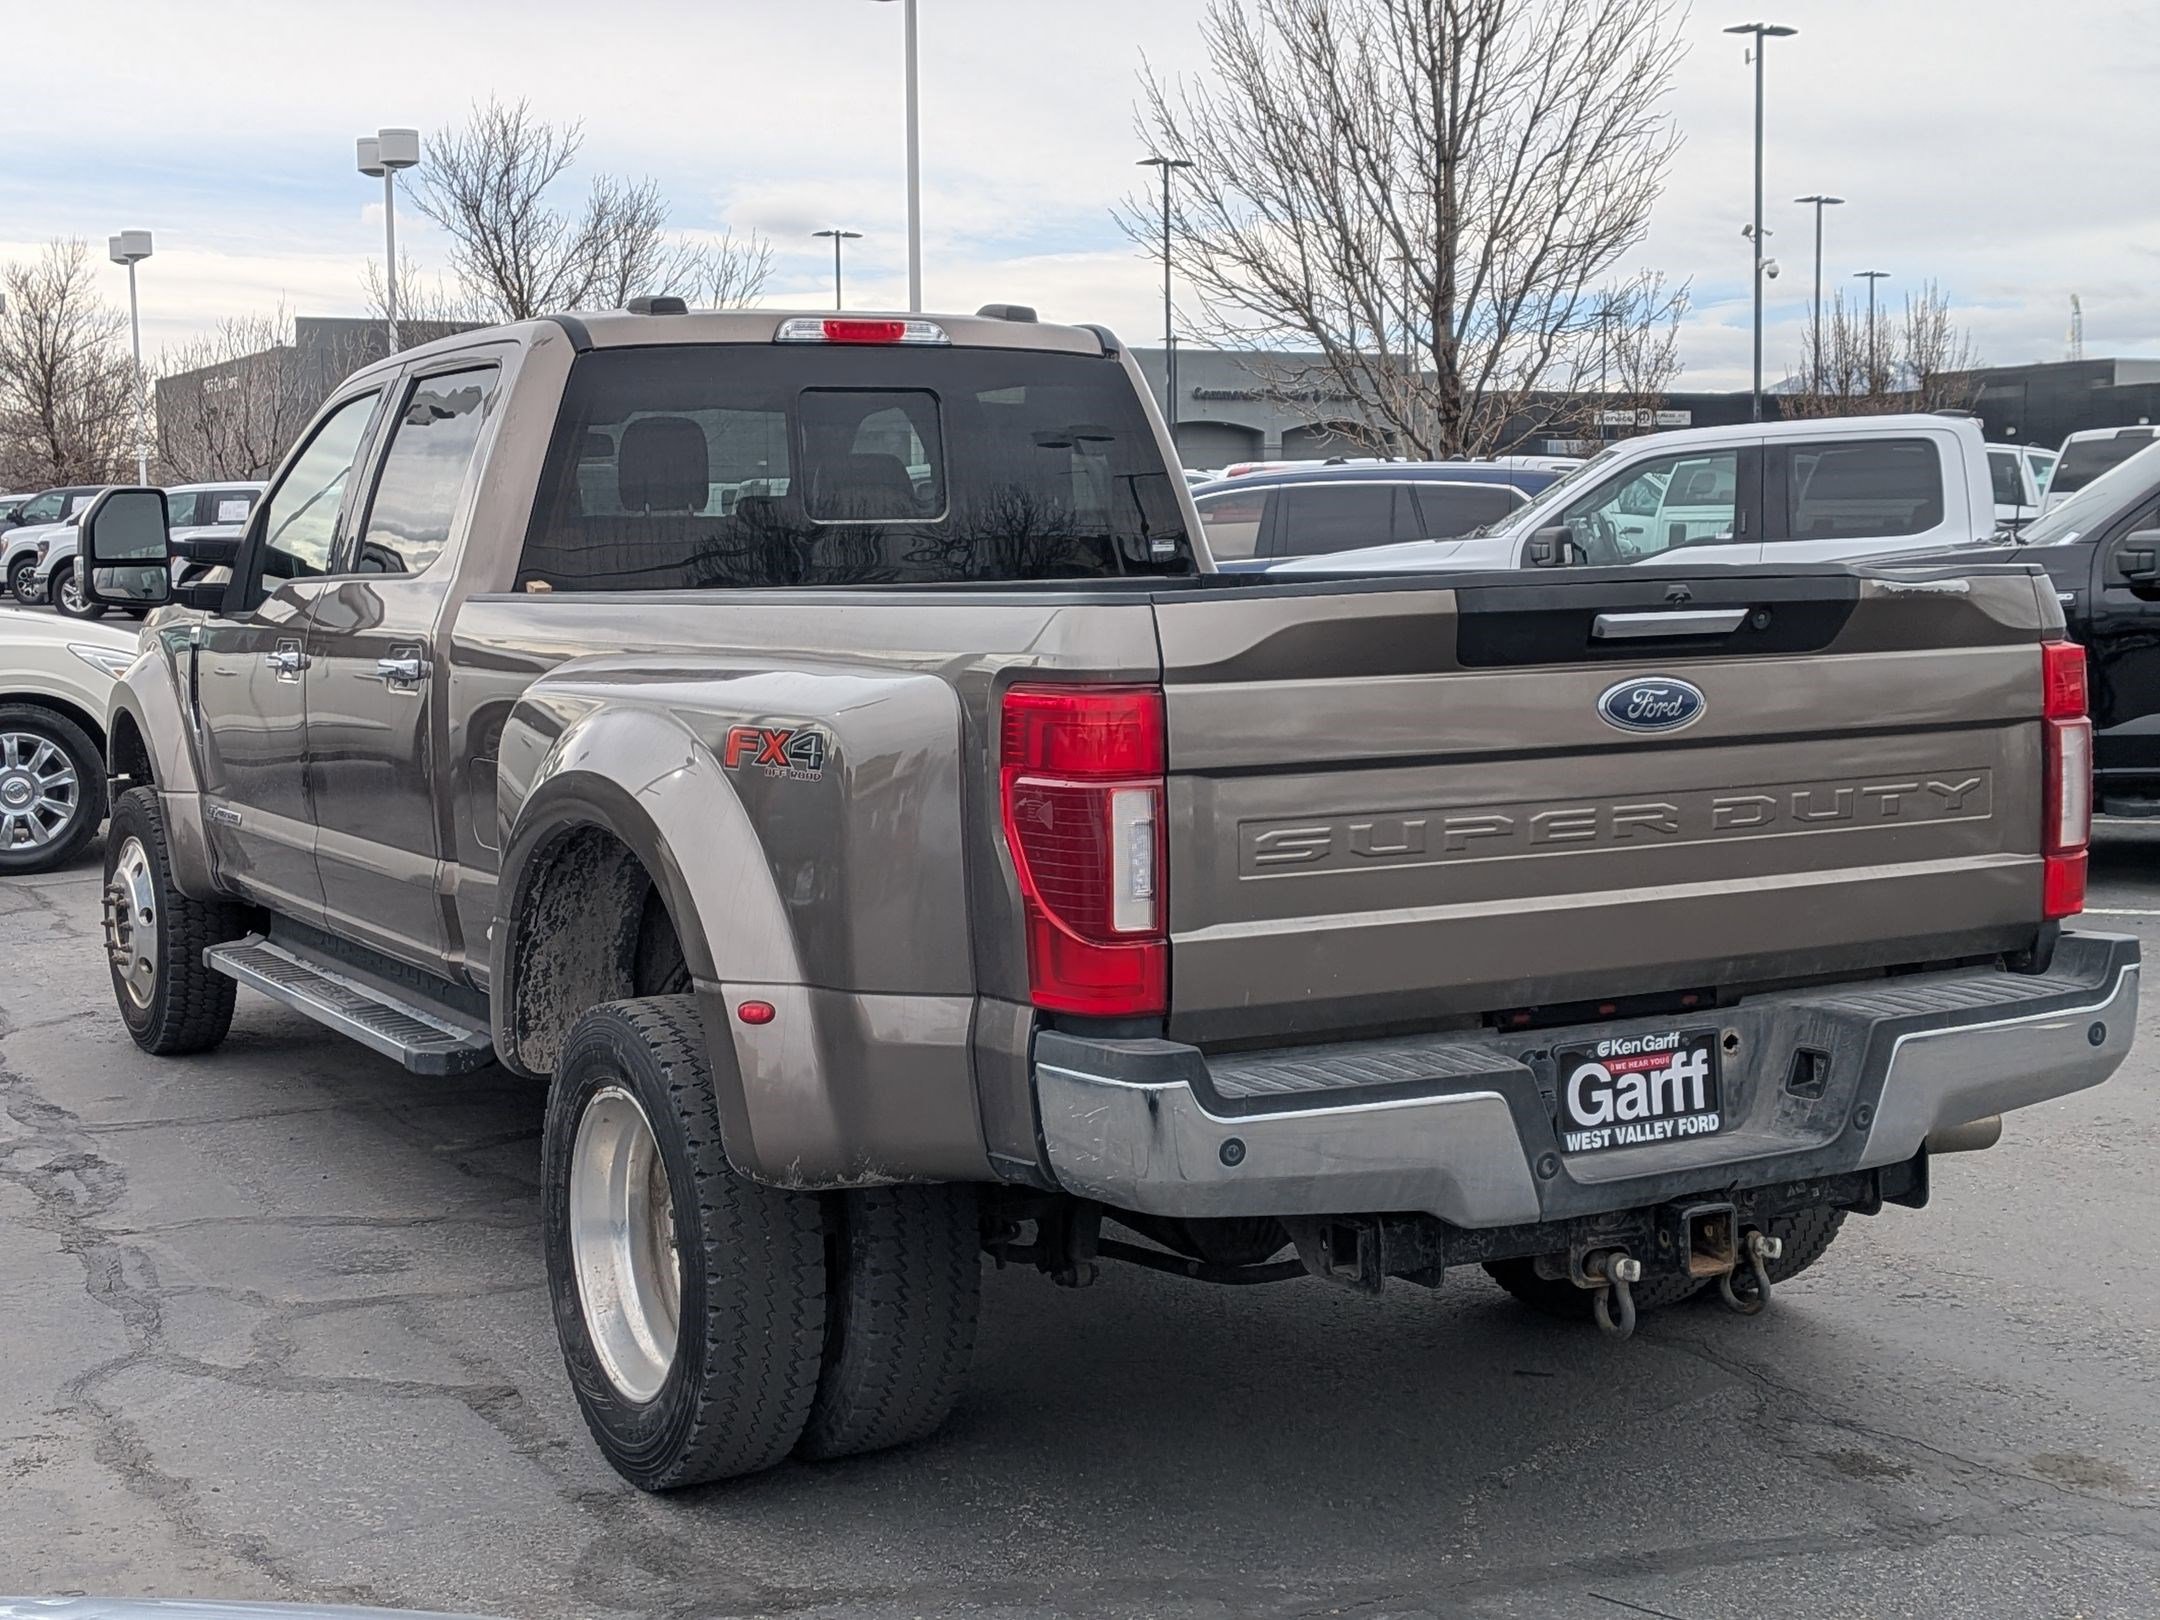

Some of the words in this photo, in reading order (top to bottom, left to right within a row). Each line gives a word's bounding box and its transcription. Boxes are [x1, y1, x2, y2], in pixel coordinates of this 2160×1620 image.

[1627, 688, 1683, 719] Ford
[723, 724, 825, 772] FX4
[763, 767, 787, 778] OFF
[789, 769, 823, 783] ROAD
[1255, 802, 1678, 866] SUPER
[1713, 777, 1981, 831] DUTY
[1610, 1038, 1641, 1056] Ken
[1642, 1031, 1681, 1052] Garff
[1628, 1059, 1650, 1070] HEAR
[1567, 1049, 1710, 1127] Garff
[1566, 1128, 1611, 1152] WEST
[1615, 1120, 1675, 1146] VALLEY
[1678, 1113, 1720, 1137] FORD
